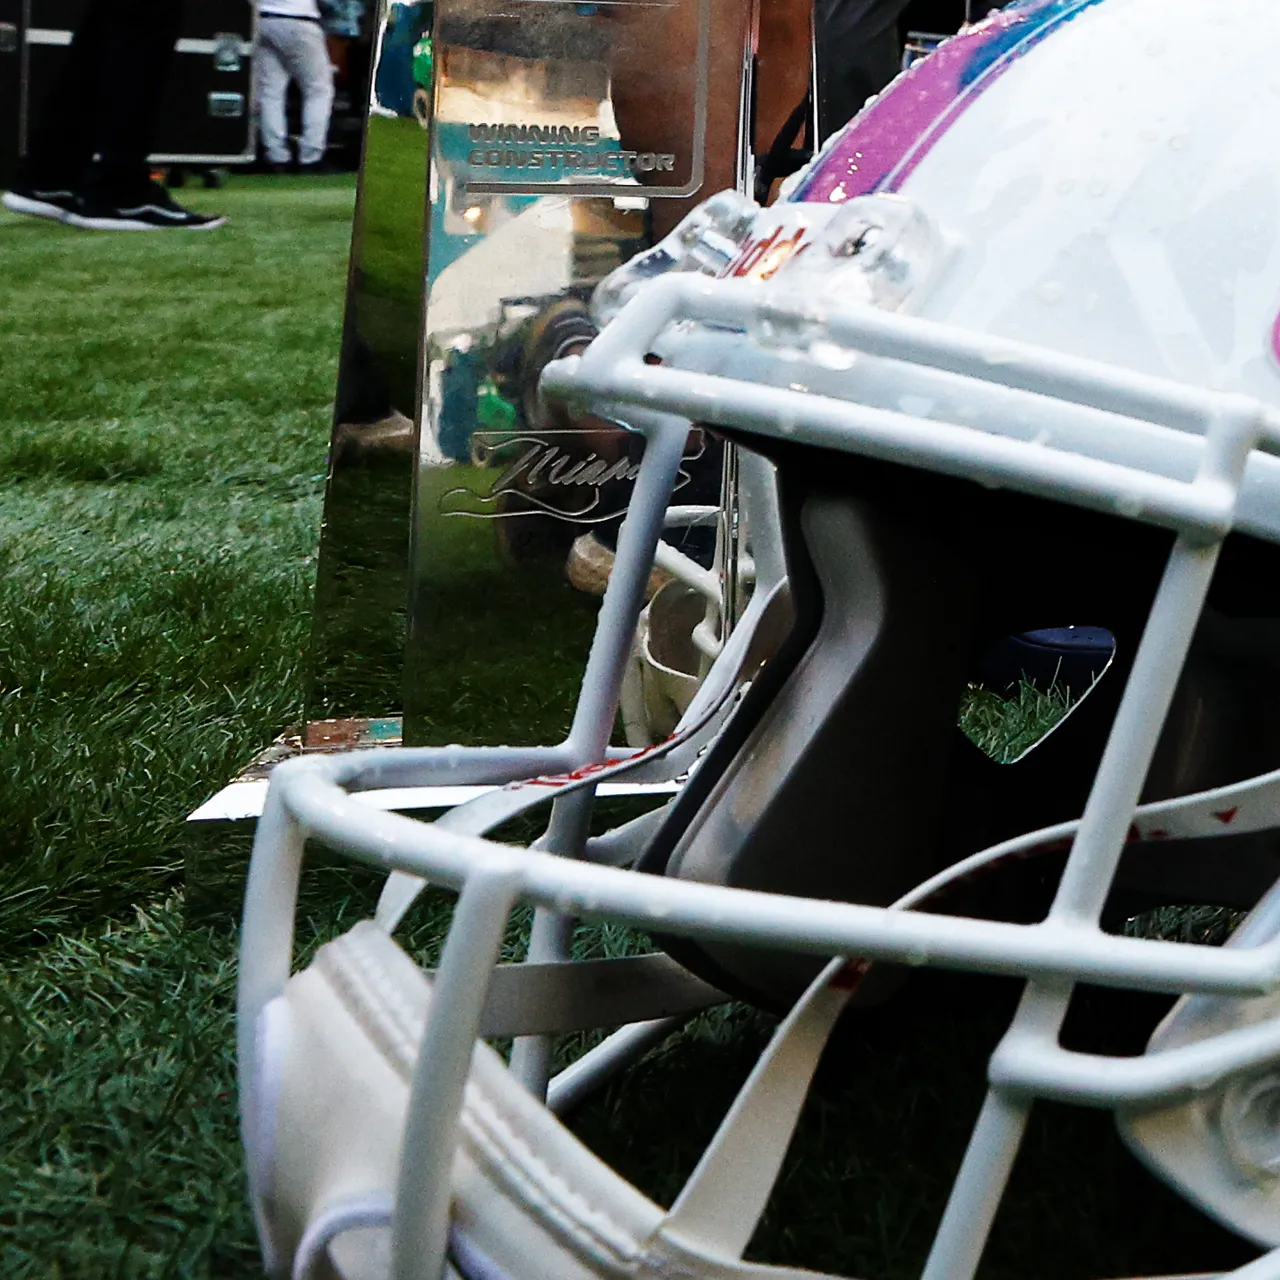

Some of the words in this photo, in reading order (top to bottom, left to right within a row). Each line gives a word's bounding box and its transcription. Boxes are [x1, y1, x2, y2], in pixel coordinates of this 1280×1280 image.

[468, 122, 600, 146] WINNING
[468, 148, 676, 171] CONSTRUCTOR
[492, 444, 641, 493] Miam
